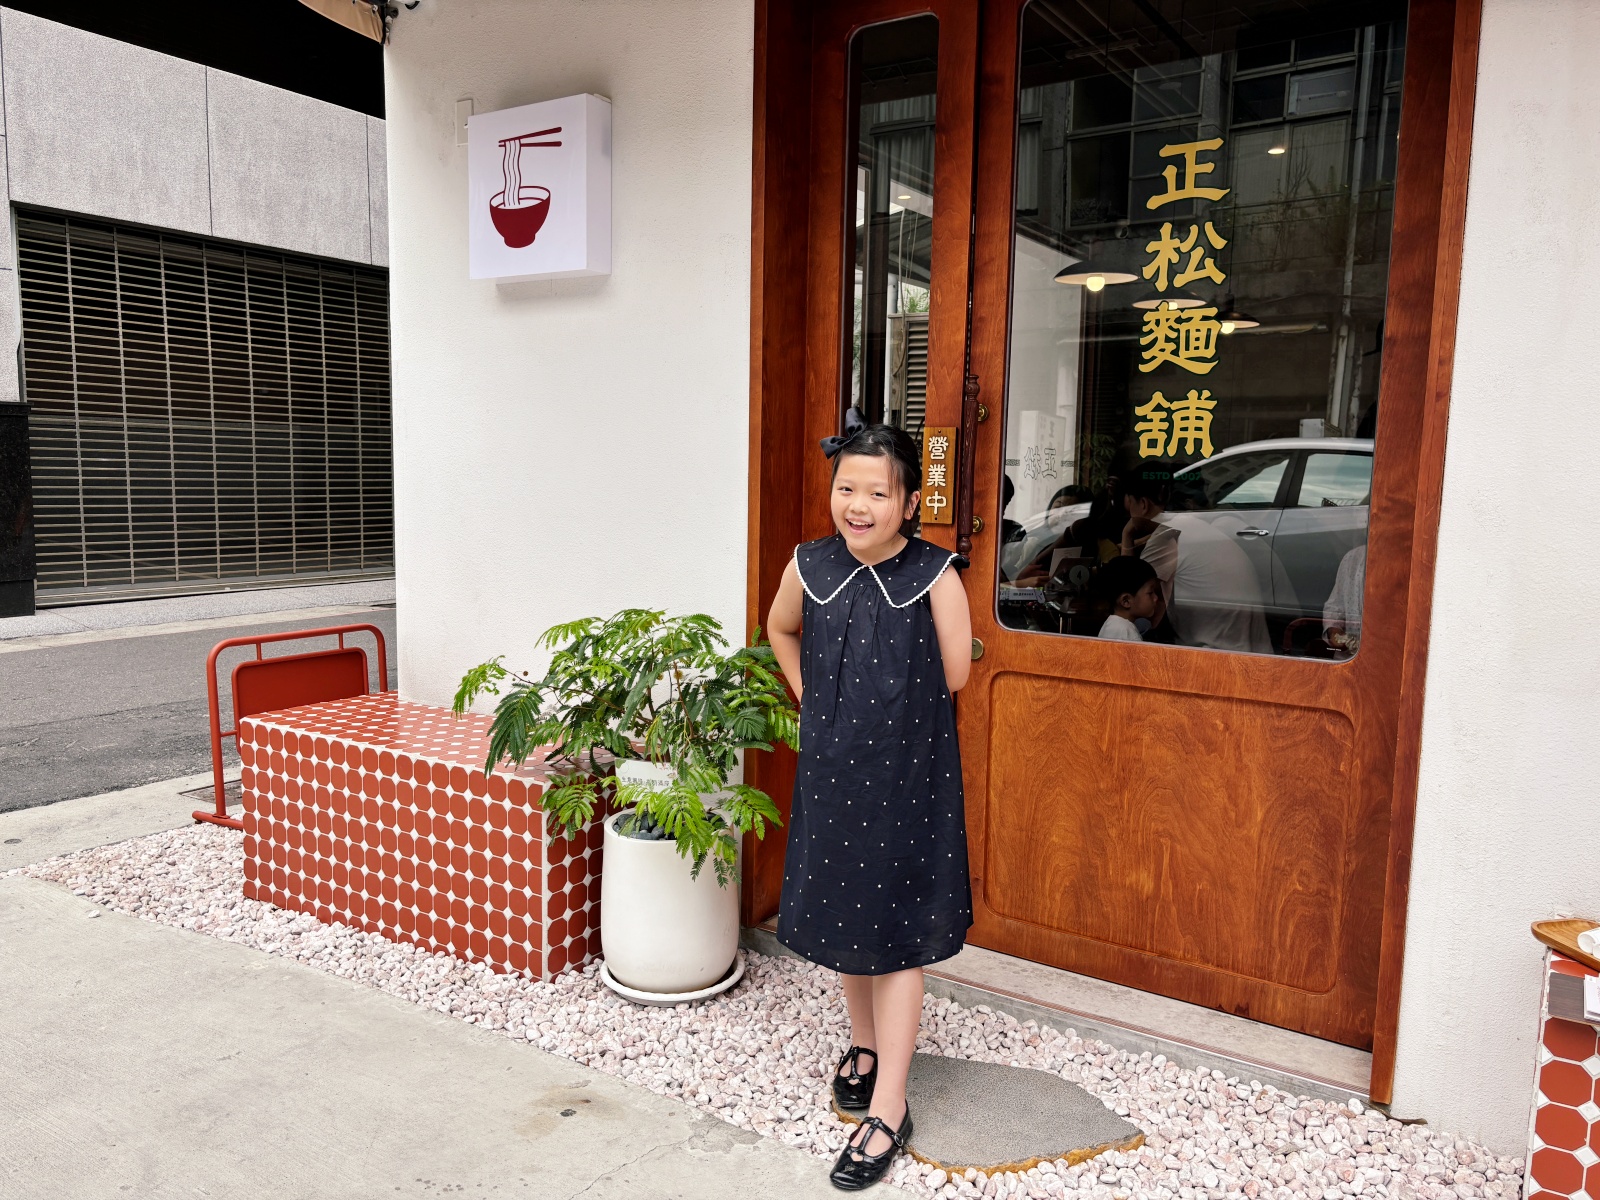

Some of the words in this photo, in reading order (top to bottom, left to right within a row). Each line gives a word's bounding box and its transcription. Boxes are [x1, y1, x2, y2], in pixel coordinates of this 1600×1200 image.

[1134, 137, 1231, 459] 正松麵舖
[926, 436, 949, 515] 營業中
[1142, 471, 1170, 480] ESTD
